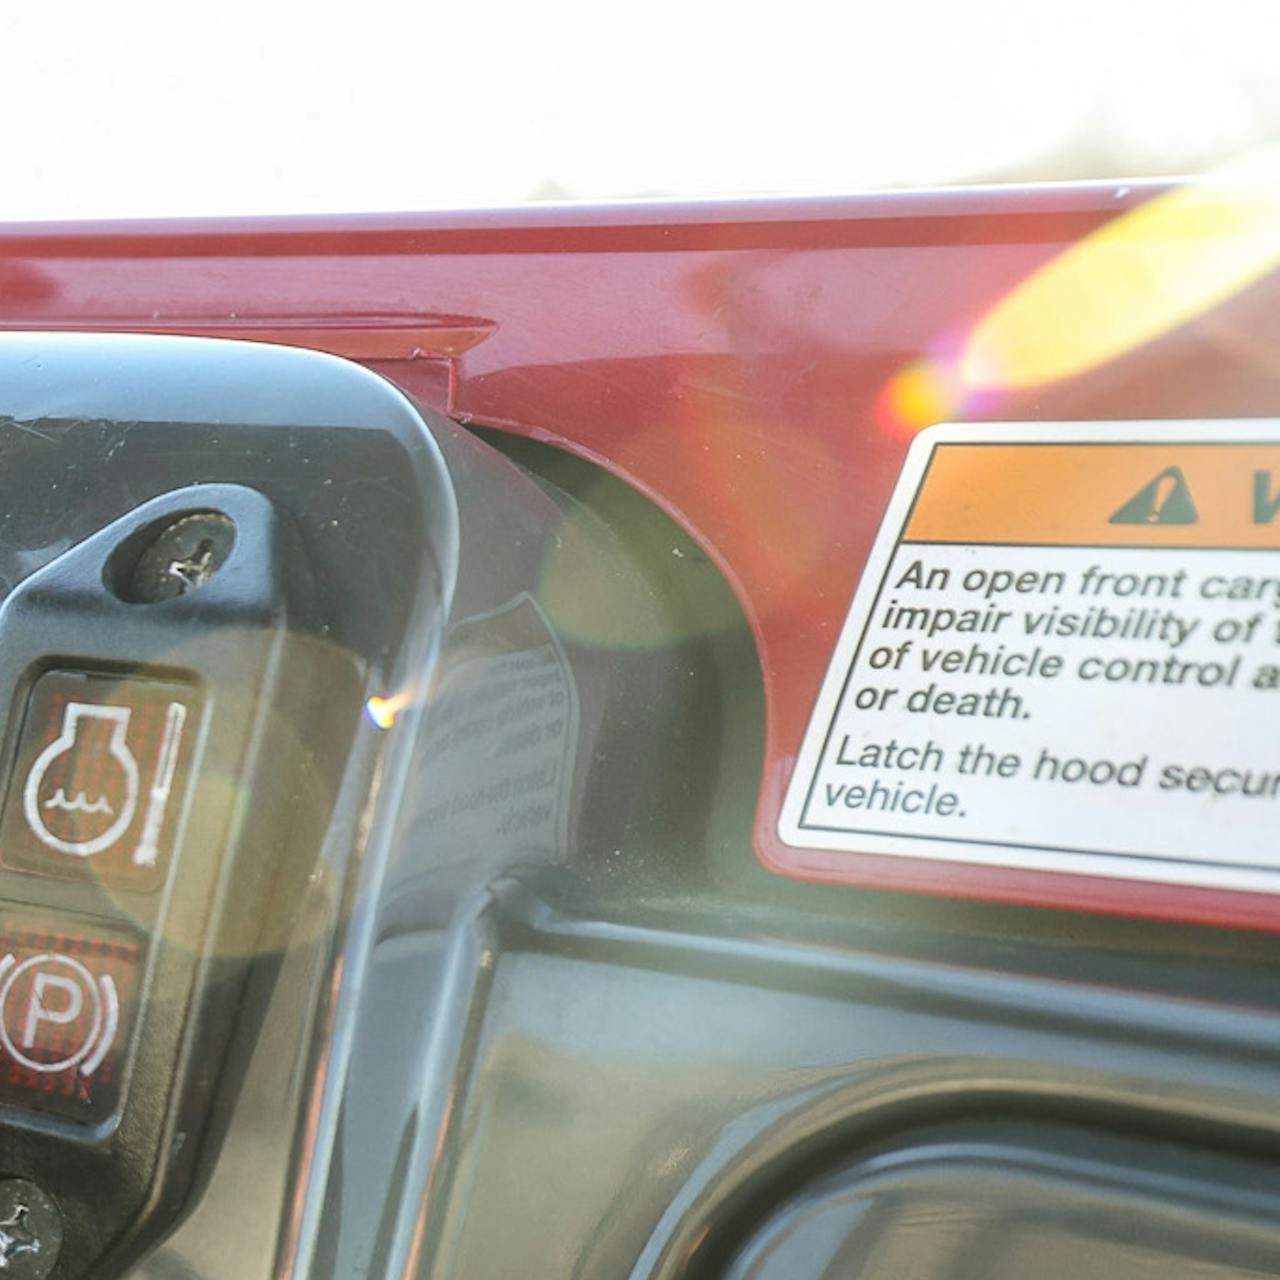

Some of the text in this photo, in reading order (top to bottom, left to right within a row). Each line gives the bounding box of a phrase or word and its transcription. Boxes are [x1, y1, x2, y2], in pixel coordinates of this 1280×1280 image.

[894, 560, 951, 591] An
[962, 566, 1066, 599] open
[1077, 565, 1187, 599] front
[881, 600, 1011, 639] impair
[1021, 608, 1199, 649] visibility
[1213, 612, 1268, 645] of
[867, 640, 914, 672] of
[921, 645, 1065, 681] vehicle
[1077, 654, 1243, 688] control
[854, 683, 1032, 719] or death.
[836, 734, 944, 774] Latch
[957, 742, 1021, 778] the
[1034, 749, 1148, 788] hood
[825, 778, 968, 819] vehicle.
[23, 970, 80, 1049] P
